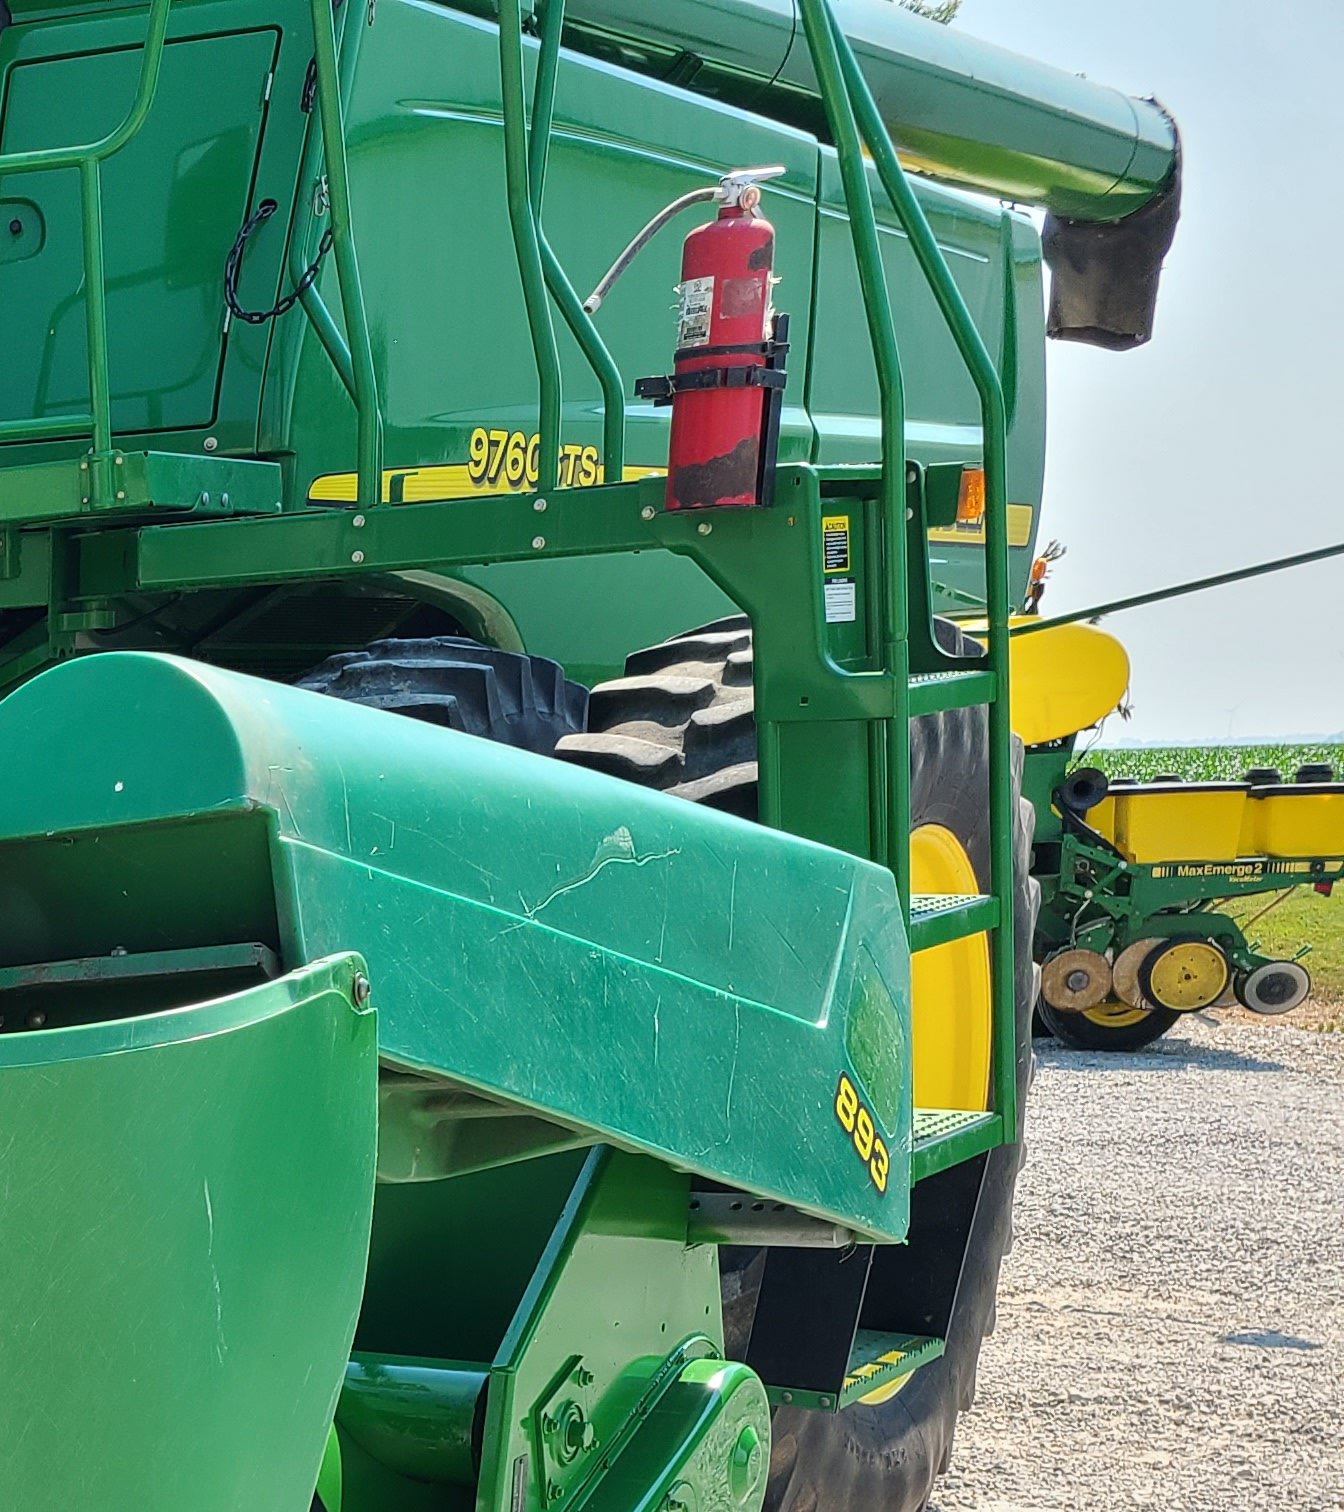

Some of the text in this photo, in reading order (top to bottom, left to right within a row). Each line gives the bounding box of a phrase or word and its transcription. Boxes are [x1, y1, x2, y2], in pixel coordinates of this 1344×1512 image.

[468, 427, 598, 487] 9760TS
[1177, 862, 1263, 877] MaxEmerge 2
[835, 1074, 890, 1194] 893
